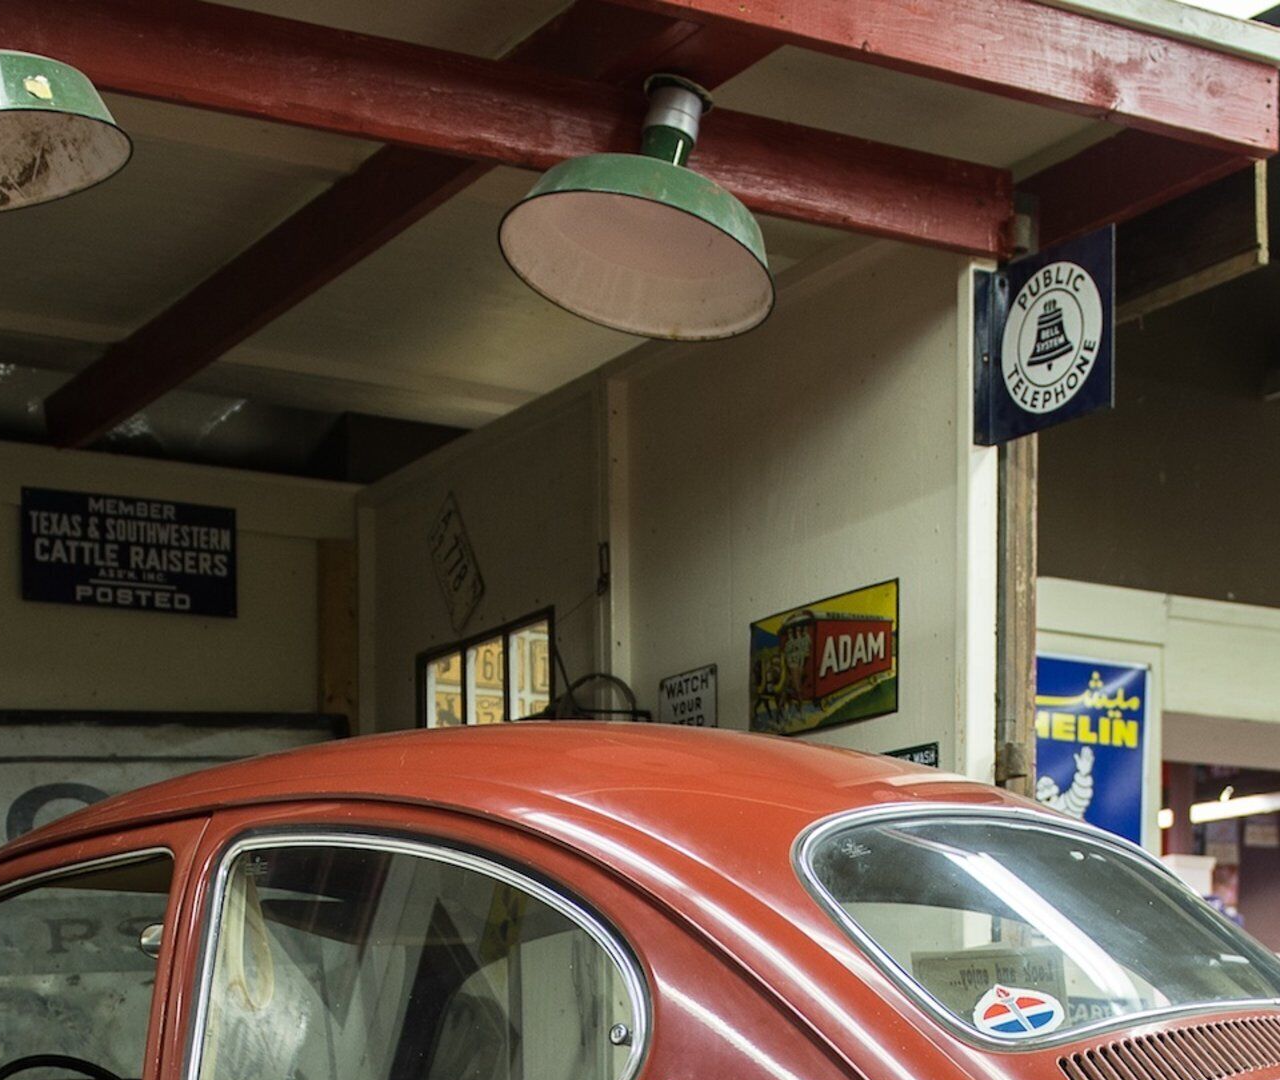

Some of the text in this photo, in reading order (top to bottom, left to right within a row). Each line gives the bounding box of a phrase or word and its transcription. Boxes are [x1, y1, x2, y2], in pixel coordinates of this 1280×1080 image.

[1018, 266, 1085, 311] PUBLIC
[1036, 335, 1065, 353] SYSTEM
[1041, 325, 1060, 340] BELL
[1007, 339, 1096, 409] TELEPHONE
[87, 497, 176, 521] MEMBER
[28, 510, 232, 552] TEXAS & SOUTHWESTERN
[33, 537, 229, 578] CATTLE RAISERS
[74, 584, 193, 611] POSTED
[819, 630, 886, 678] ADAM
[665, 671, 710, 699] WATCH
[672, 697, 703, 715] YOUR
[1035, 710, 1138, 749] HELIN
